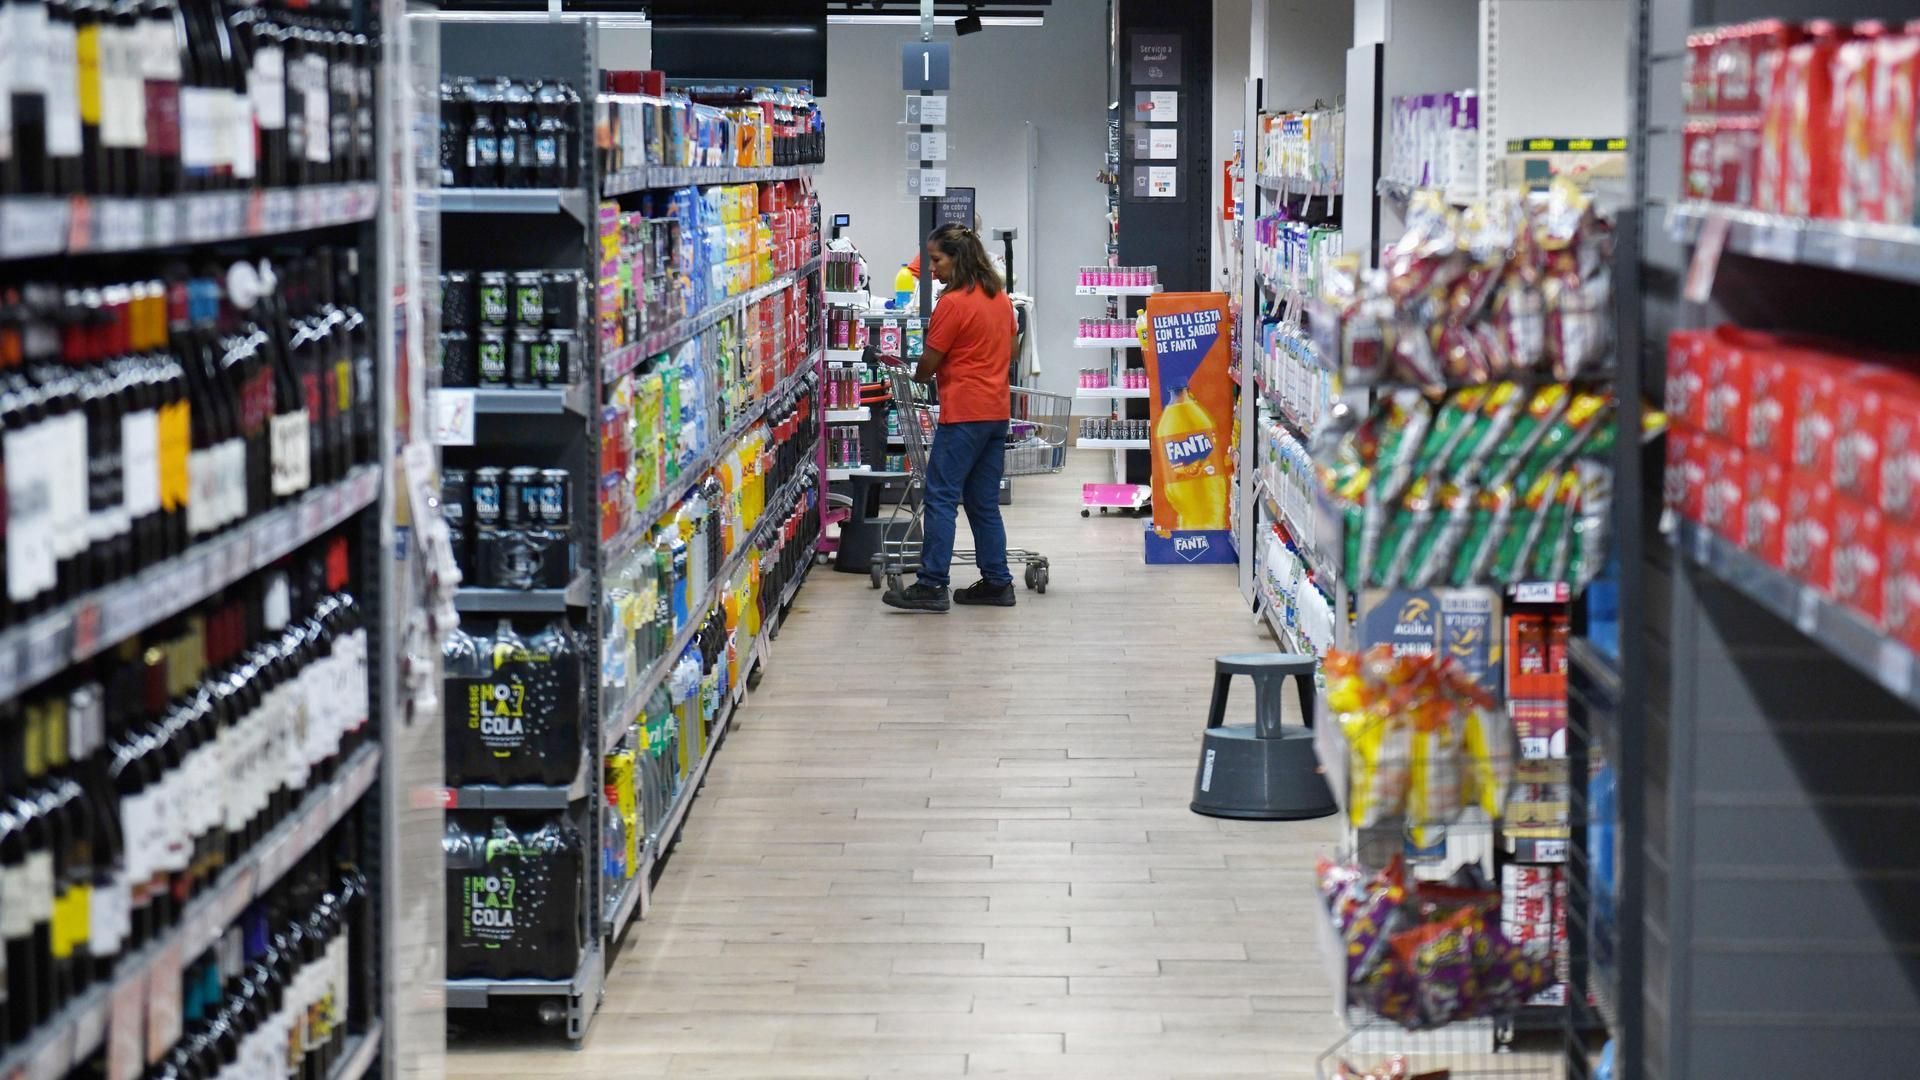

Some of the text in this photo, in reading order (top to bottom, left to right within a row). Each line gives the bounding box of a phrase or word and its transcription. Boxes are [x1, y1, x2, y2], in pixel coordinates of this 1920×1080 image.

[1140, 45, 1167, 54] Servicio
[922, 51, 930, 81] 1
[942, 203, 968, 211] de cobro
[944, 211, 966, 220] en caja
[1153, 310, 1221, 329] LLENA LA CESTA
[1155, 328, 1173, 341] CON
[1175, 327, 1186, 339] EL
[1187, 323, 1217, 338] SABOR
[1156, 338, 1197, 354] DE FANTA
[1165, 434, 1213, 461] FANTA
[1175, 535, 1209, 551] FANTA
[480, 717, 524, 735] COLA
[472, 909, 514, 927] COLA
